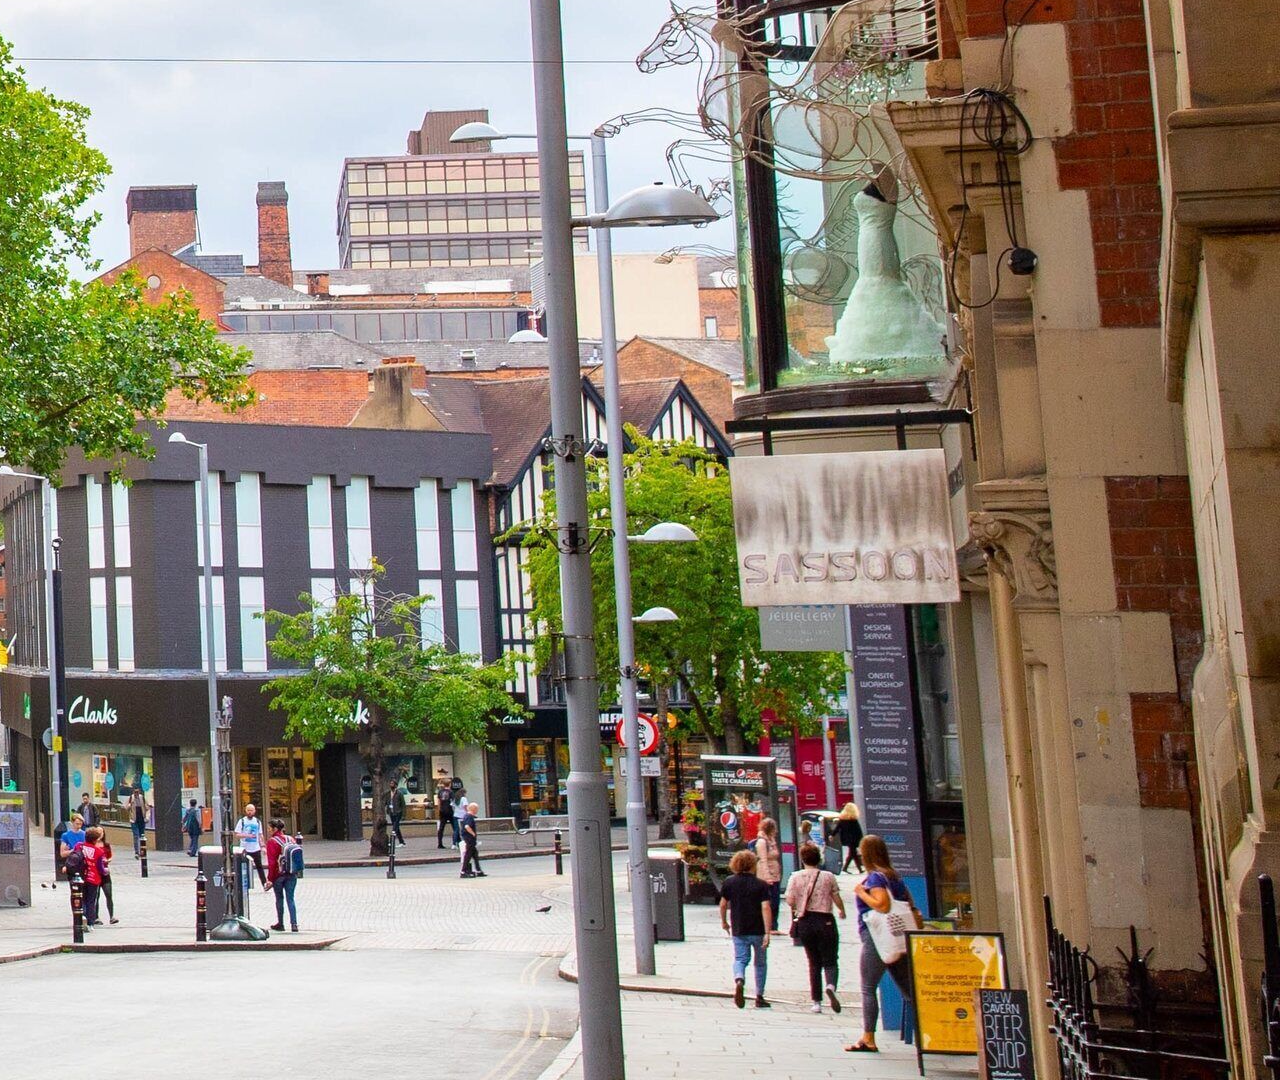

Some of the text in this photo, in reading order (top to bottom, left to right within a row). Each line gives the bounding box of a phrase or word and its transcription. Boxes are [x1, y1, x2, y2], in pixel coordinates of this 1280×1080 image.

[743, 548, 952, 583] SASSOON
[768, 611, 837, 621] JEWELLERY
[68, 695, 118, 725] Clarks
[864, 737, 901, 745] CLEANING
[867, 746, 907, 754] POLISHING
[730, 778, 763, 786] CHALLENGE
[982, 991, 1012, 1003] BREW
[982, 1003, 1020, 1014] CAVERN
[983, 1014, 1026, 1041] BEER
[986, 1040, 1027, 1069] SHOP
